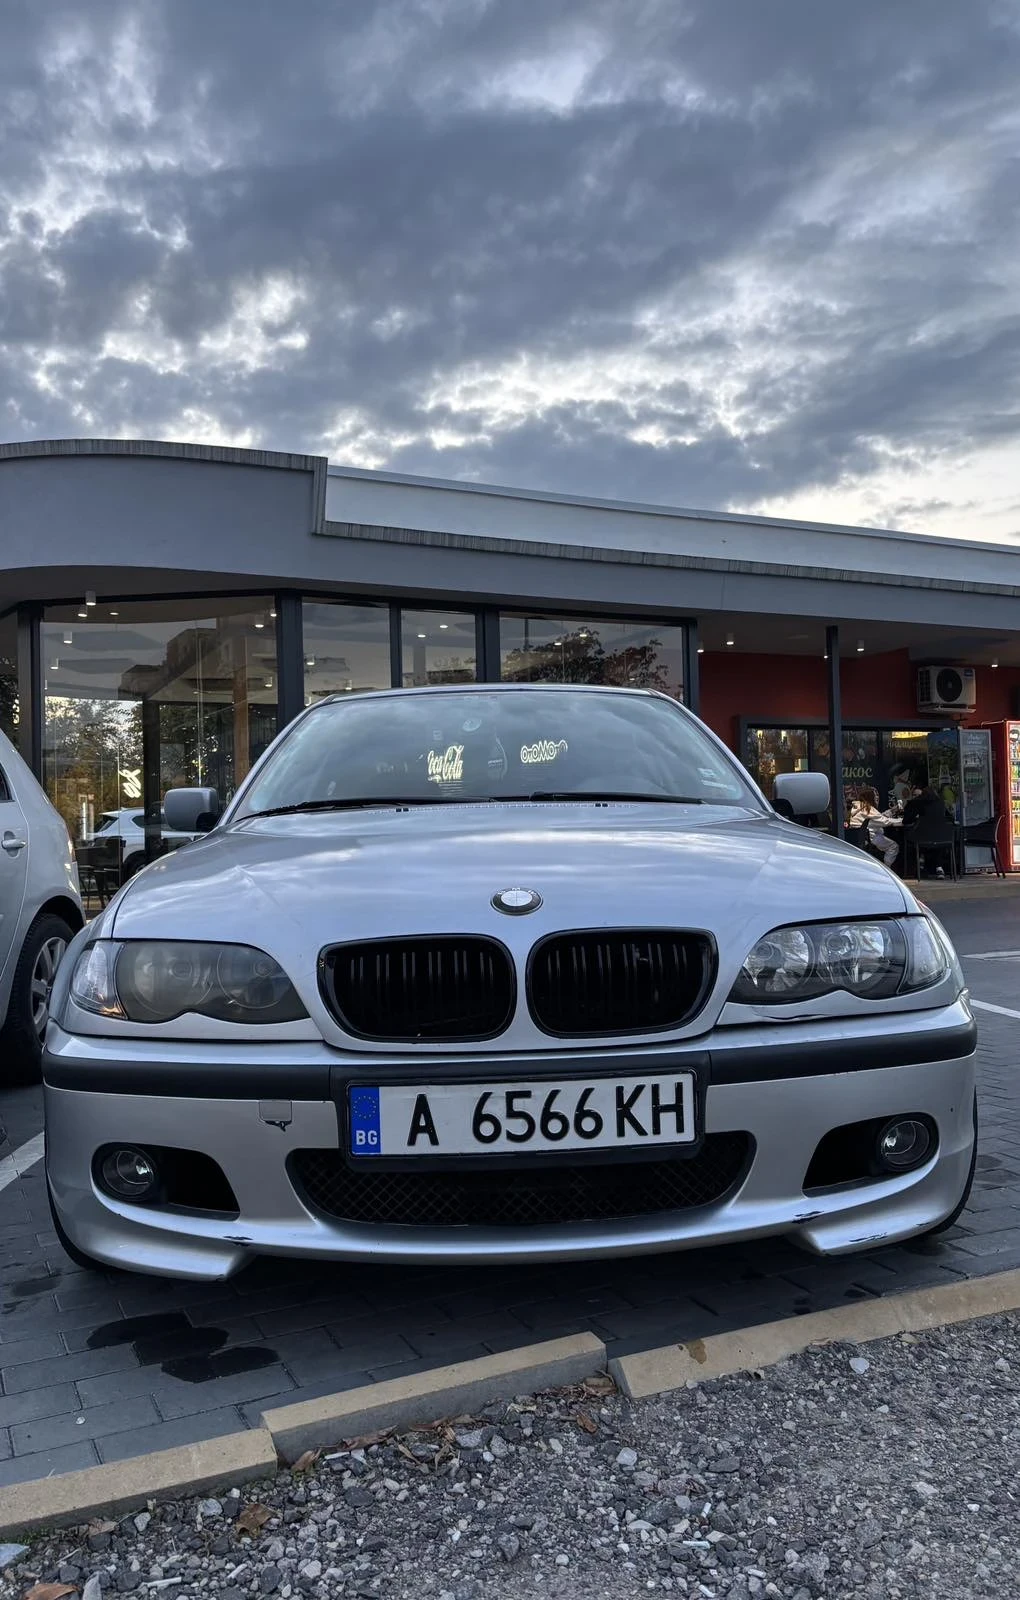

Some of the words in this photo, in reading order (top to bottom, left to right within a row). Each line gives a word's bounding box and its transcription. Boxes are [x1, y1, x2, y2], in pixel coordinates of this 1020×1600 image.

[841, 766, 874, 779] акос
[407, 1093, 440, 1147] A
[472, 1087, 603, 1144] 6566
[615, 1081, 685, 1138] KH
[355, 1129, 378, 1146] BG
